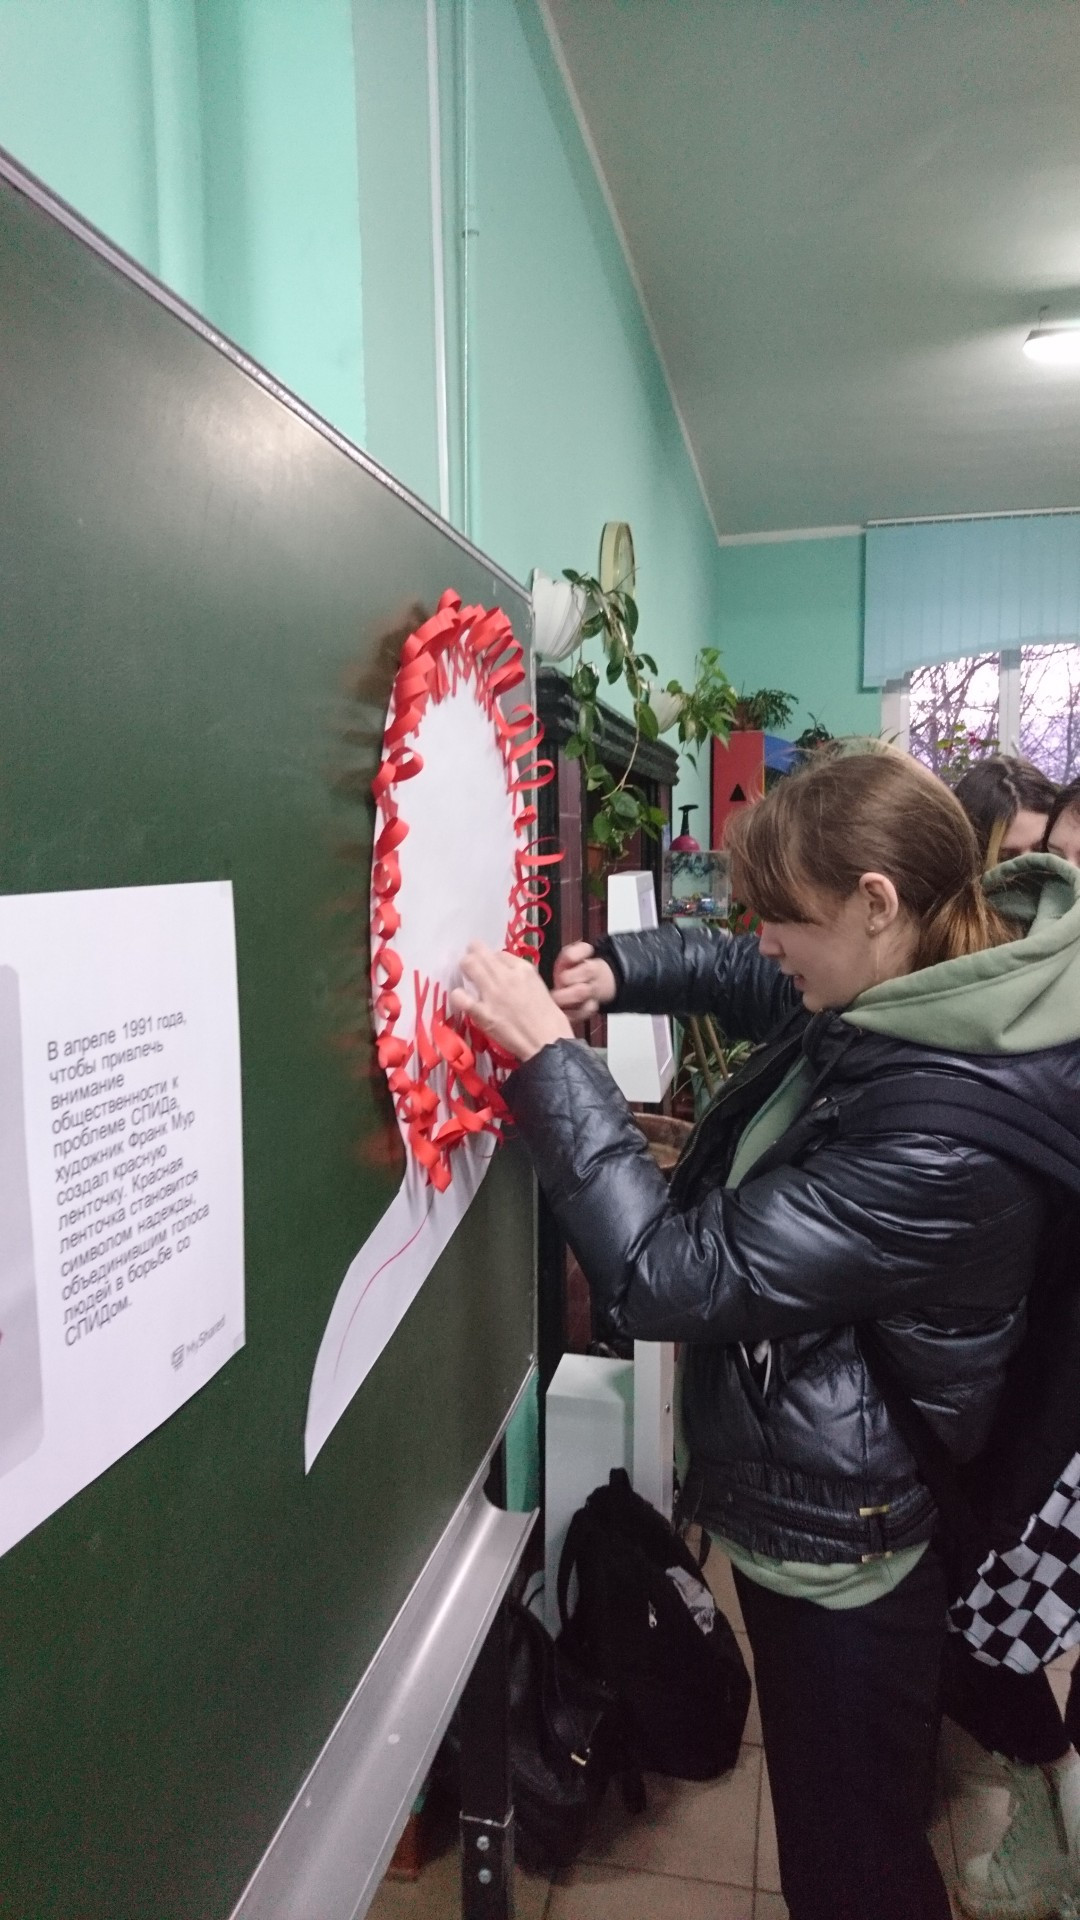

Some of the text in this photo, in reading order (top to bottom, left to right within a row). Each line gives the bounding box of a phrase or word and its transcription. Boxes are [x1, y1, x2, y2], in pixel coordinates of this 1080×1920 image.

[47, 1011, 187, 1061] В апреле 1991 года,
[50, 1039, 164, 1084] чтобы привлечь
[51, 1073, 125, 1110] внимание
[52, 1076, 179, 1134] общественности к
[53, 1118, 126, 1159] проблеме
[55, 1110, 196, 1184] художник Франк Мур
[56, 1144, 167, 1206] создал красную
[58, 1157, 184, 1231] ленточку. Красная
[59, 1169, 199, 1254] ленточка становится
[61, 1226, 133, 1277] символом
[62, 1204, 210, 1301] объединившим голоса
[63, 1236, 191, 1325] людей в борьбе со
[65, 1296, 133, 1347] СПИДом.
